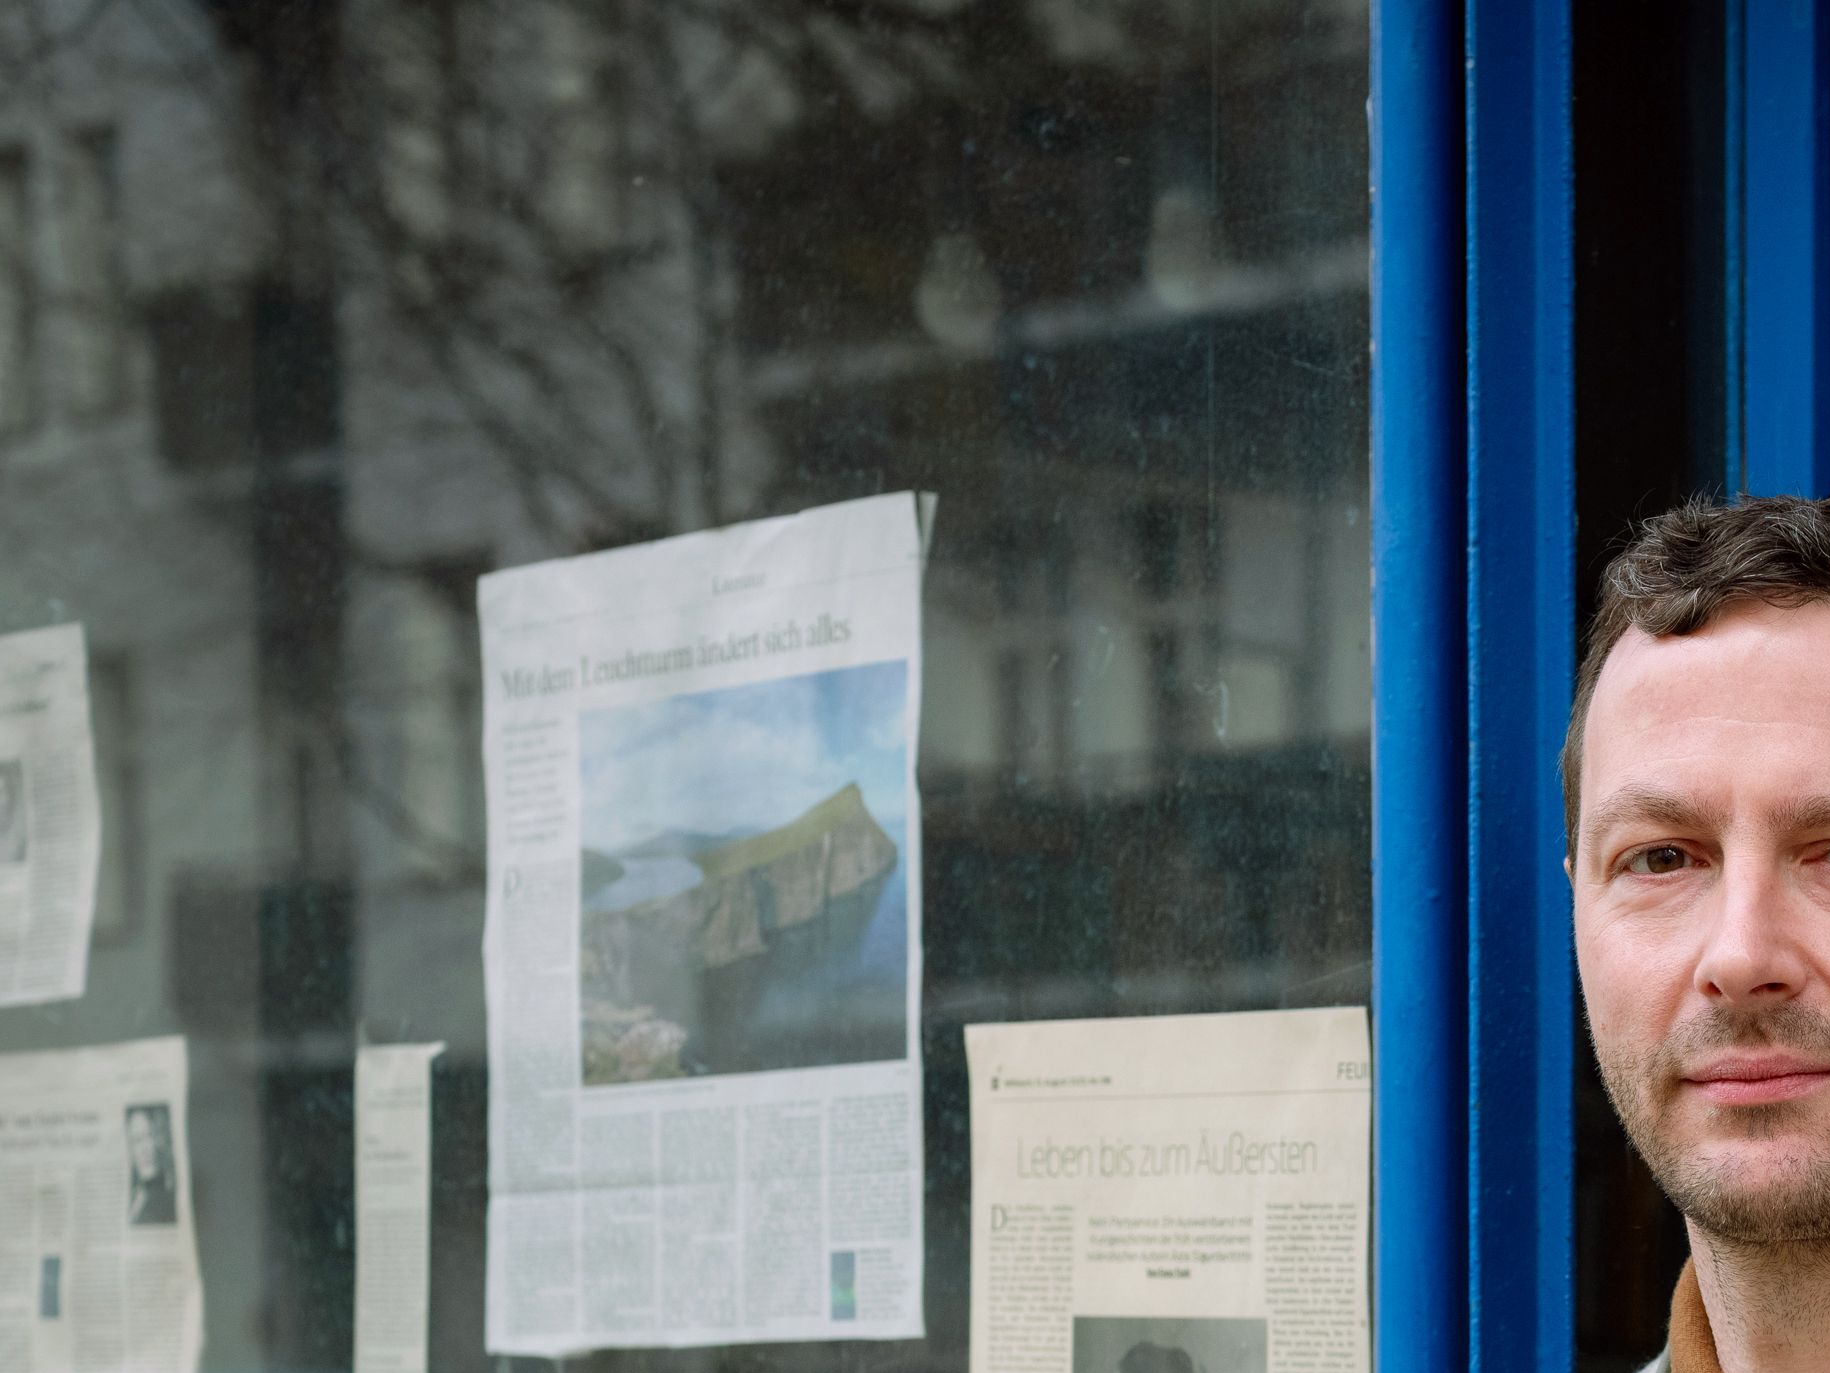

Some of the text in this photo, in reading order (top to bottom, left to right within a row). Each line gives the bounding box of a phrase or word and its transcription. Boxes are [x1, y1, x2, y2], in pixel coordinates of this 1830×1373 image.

[1015, 1129, 1319, 1179] Leben bis zum Äußersten
